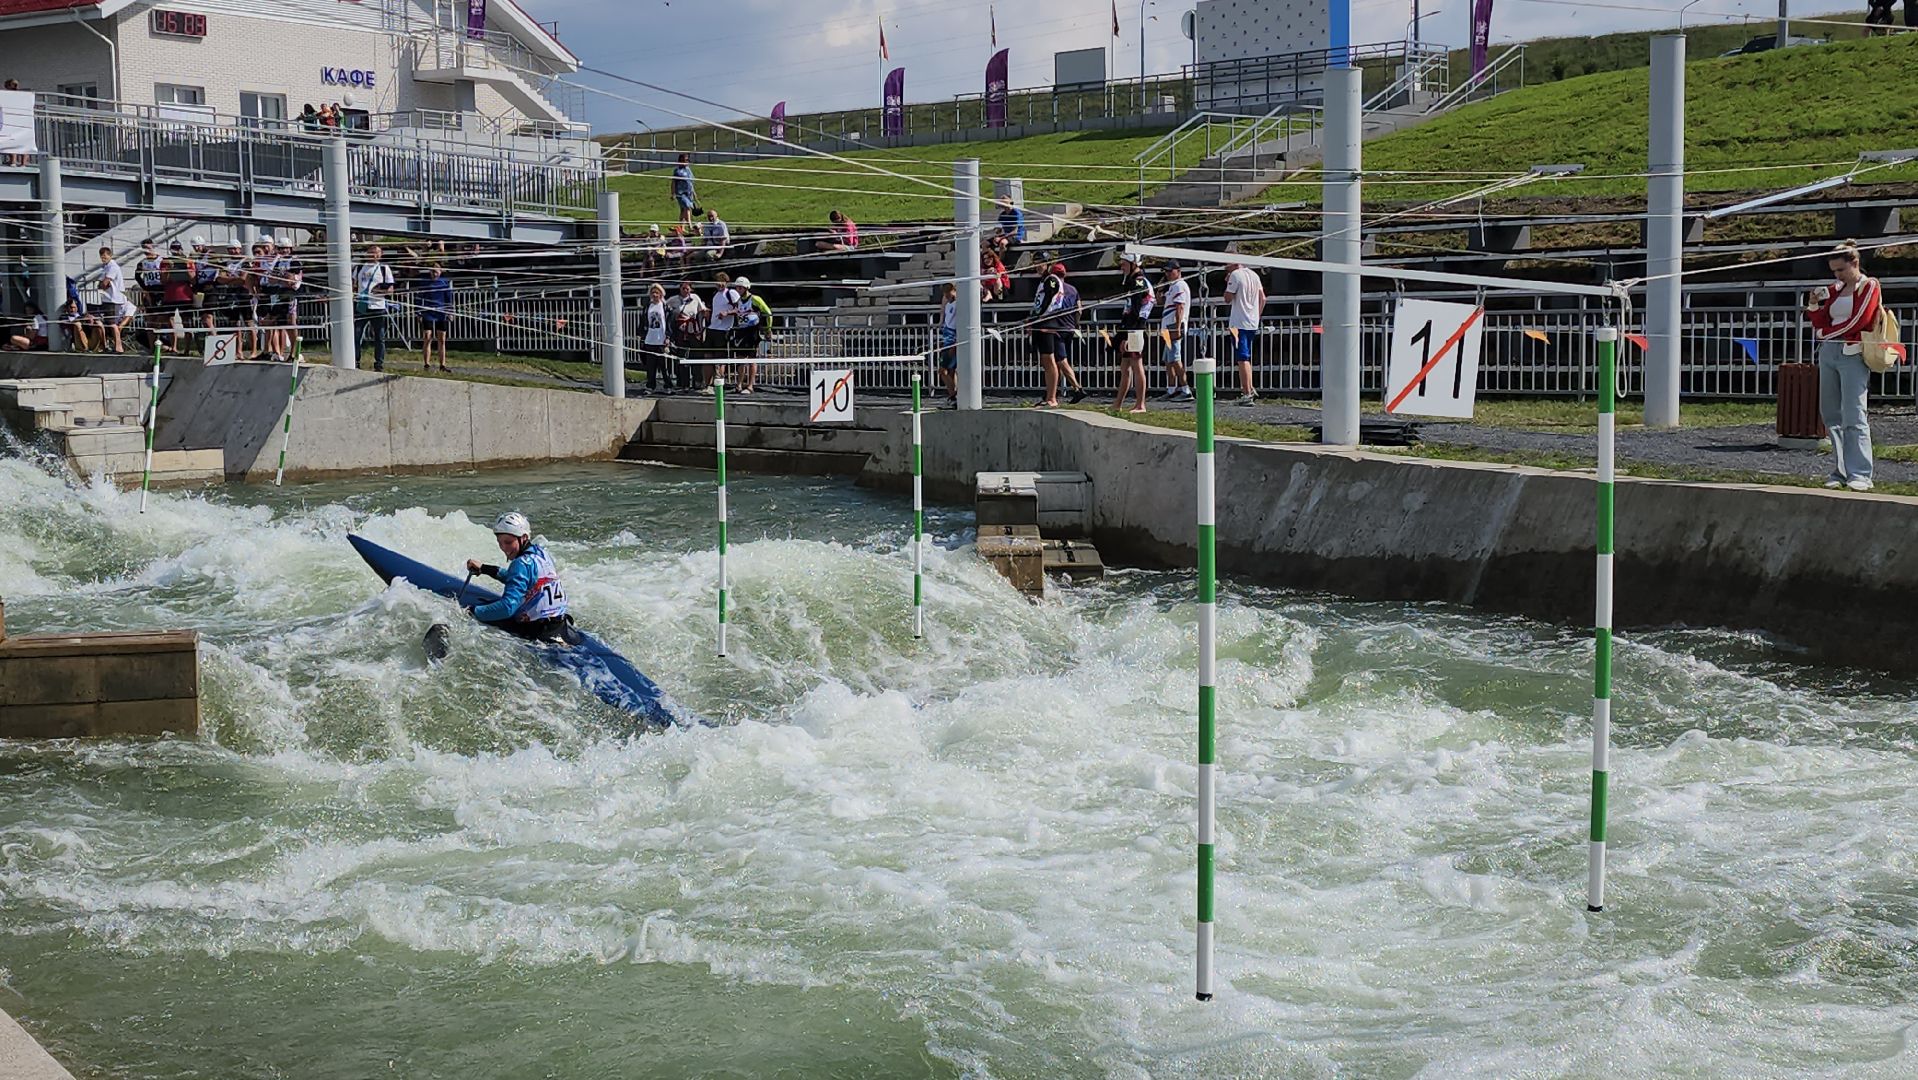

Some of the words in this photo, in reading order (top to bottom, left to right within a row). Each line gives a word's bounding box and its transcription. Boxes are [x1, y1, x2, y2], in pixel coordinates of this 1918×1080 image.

[323, 66, 375, 86] КАФЕ
[215, 339, 226, 360] 8
[1410, 319, 1466, 399] 11
[815, 377, 850, 413] 10
[543, 581, 567, 605] 14
